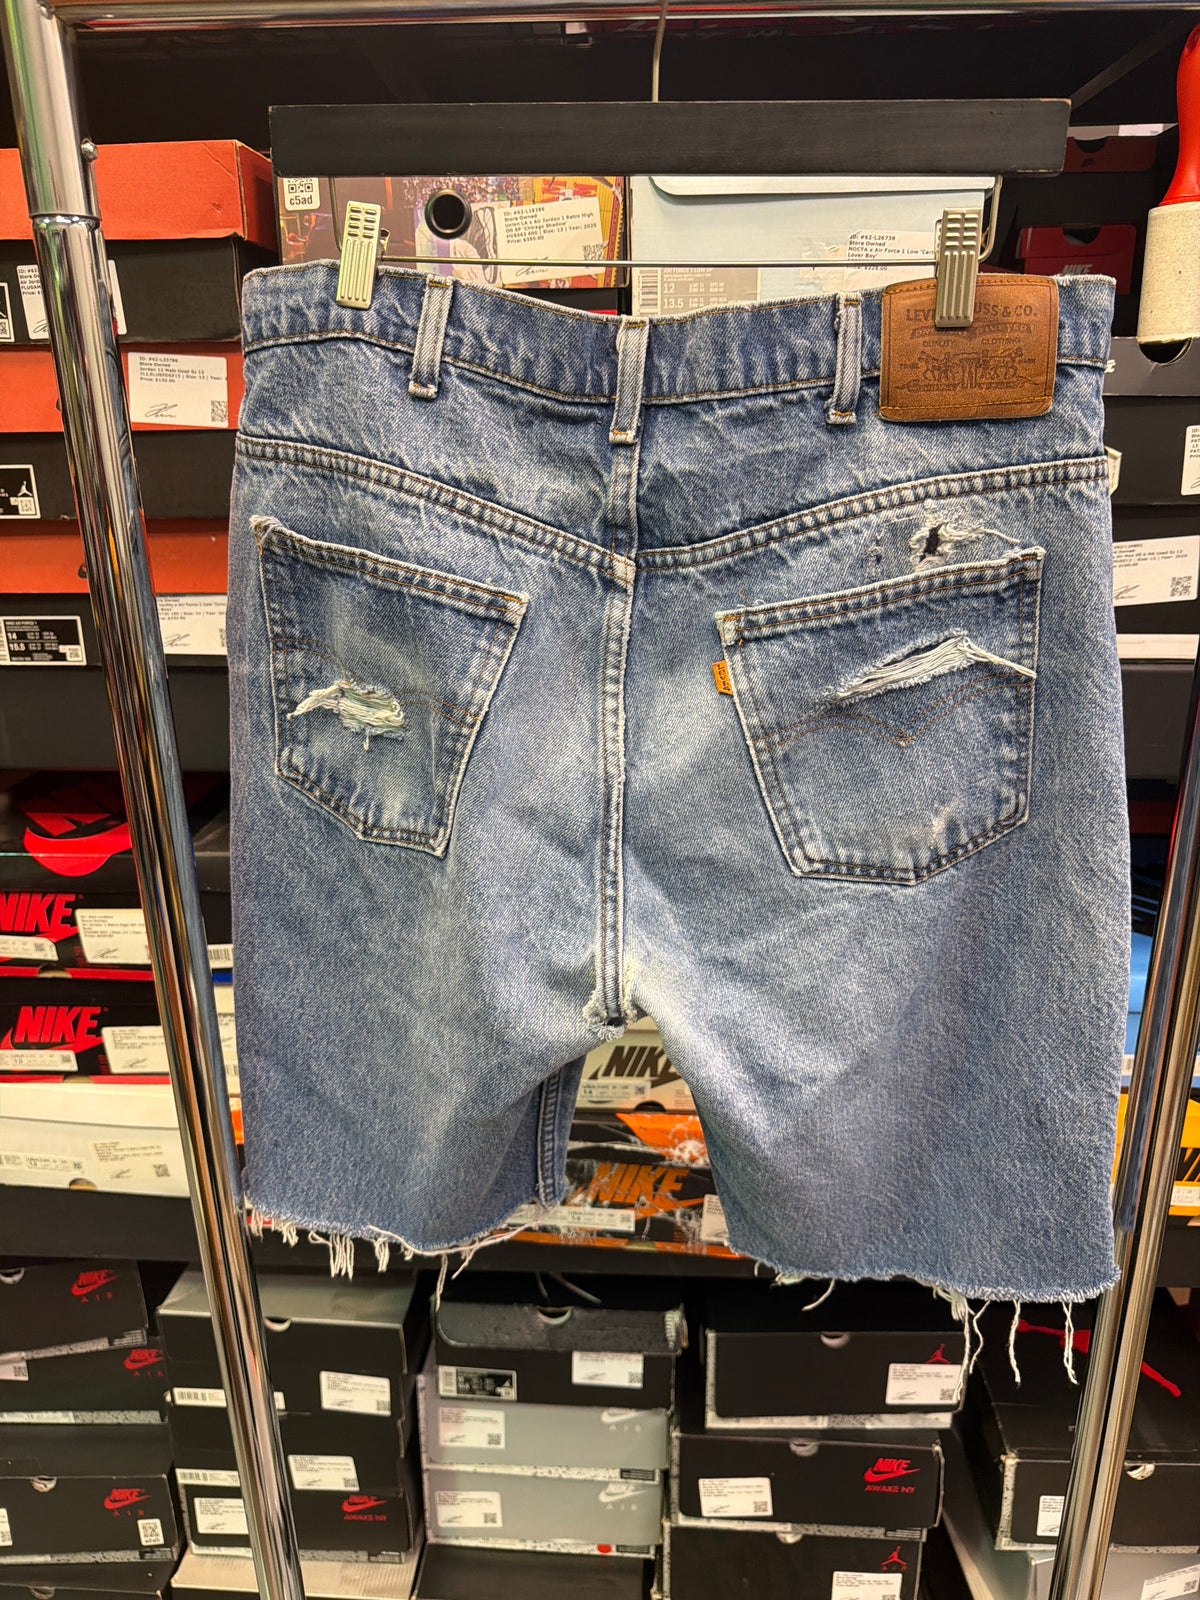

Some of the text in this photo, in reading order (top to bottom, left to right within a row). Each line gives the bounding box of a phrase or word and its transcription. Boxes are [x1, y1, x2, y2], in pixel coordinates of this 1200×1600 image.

[290, 195, 313, 206] c5ad
[664, 283, 676, 294] 12
[664, 298, 684, 308] 13.5
[1002, 305, 1012, 318] &
[1014, 304, 1038, 318] CO.
[0, 893, 76, 932] NIKE
[14, 1006, 101, 1044] NIKE
[588, 1163, 690, 1203] NIKE
[77, 1270, 113, 1286] NIKE
[130, 1349, 164, 1361] NIKE
[872, 1458, 911, 1472] NIKE
[110, 1488, 145, 1500] NIKE
[864, 1485, 899, 1494] AWAKE
